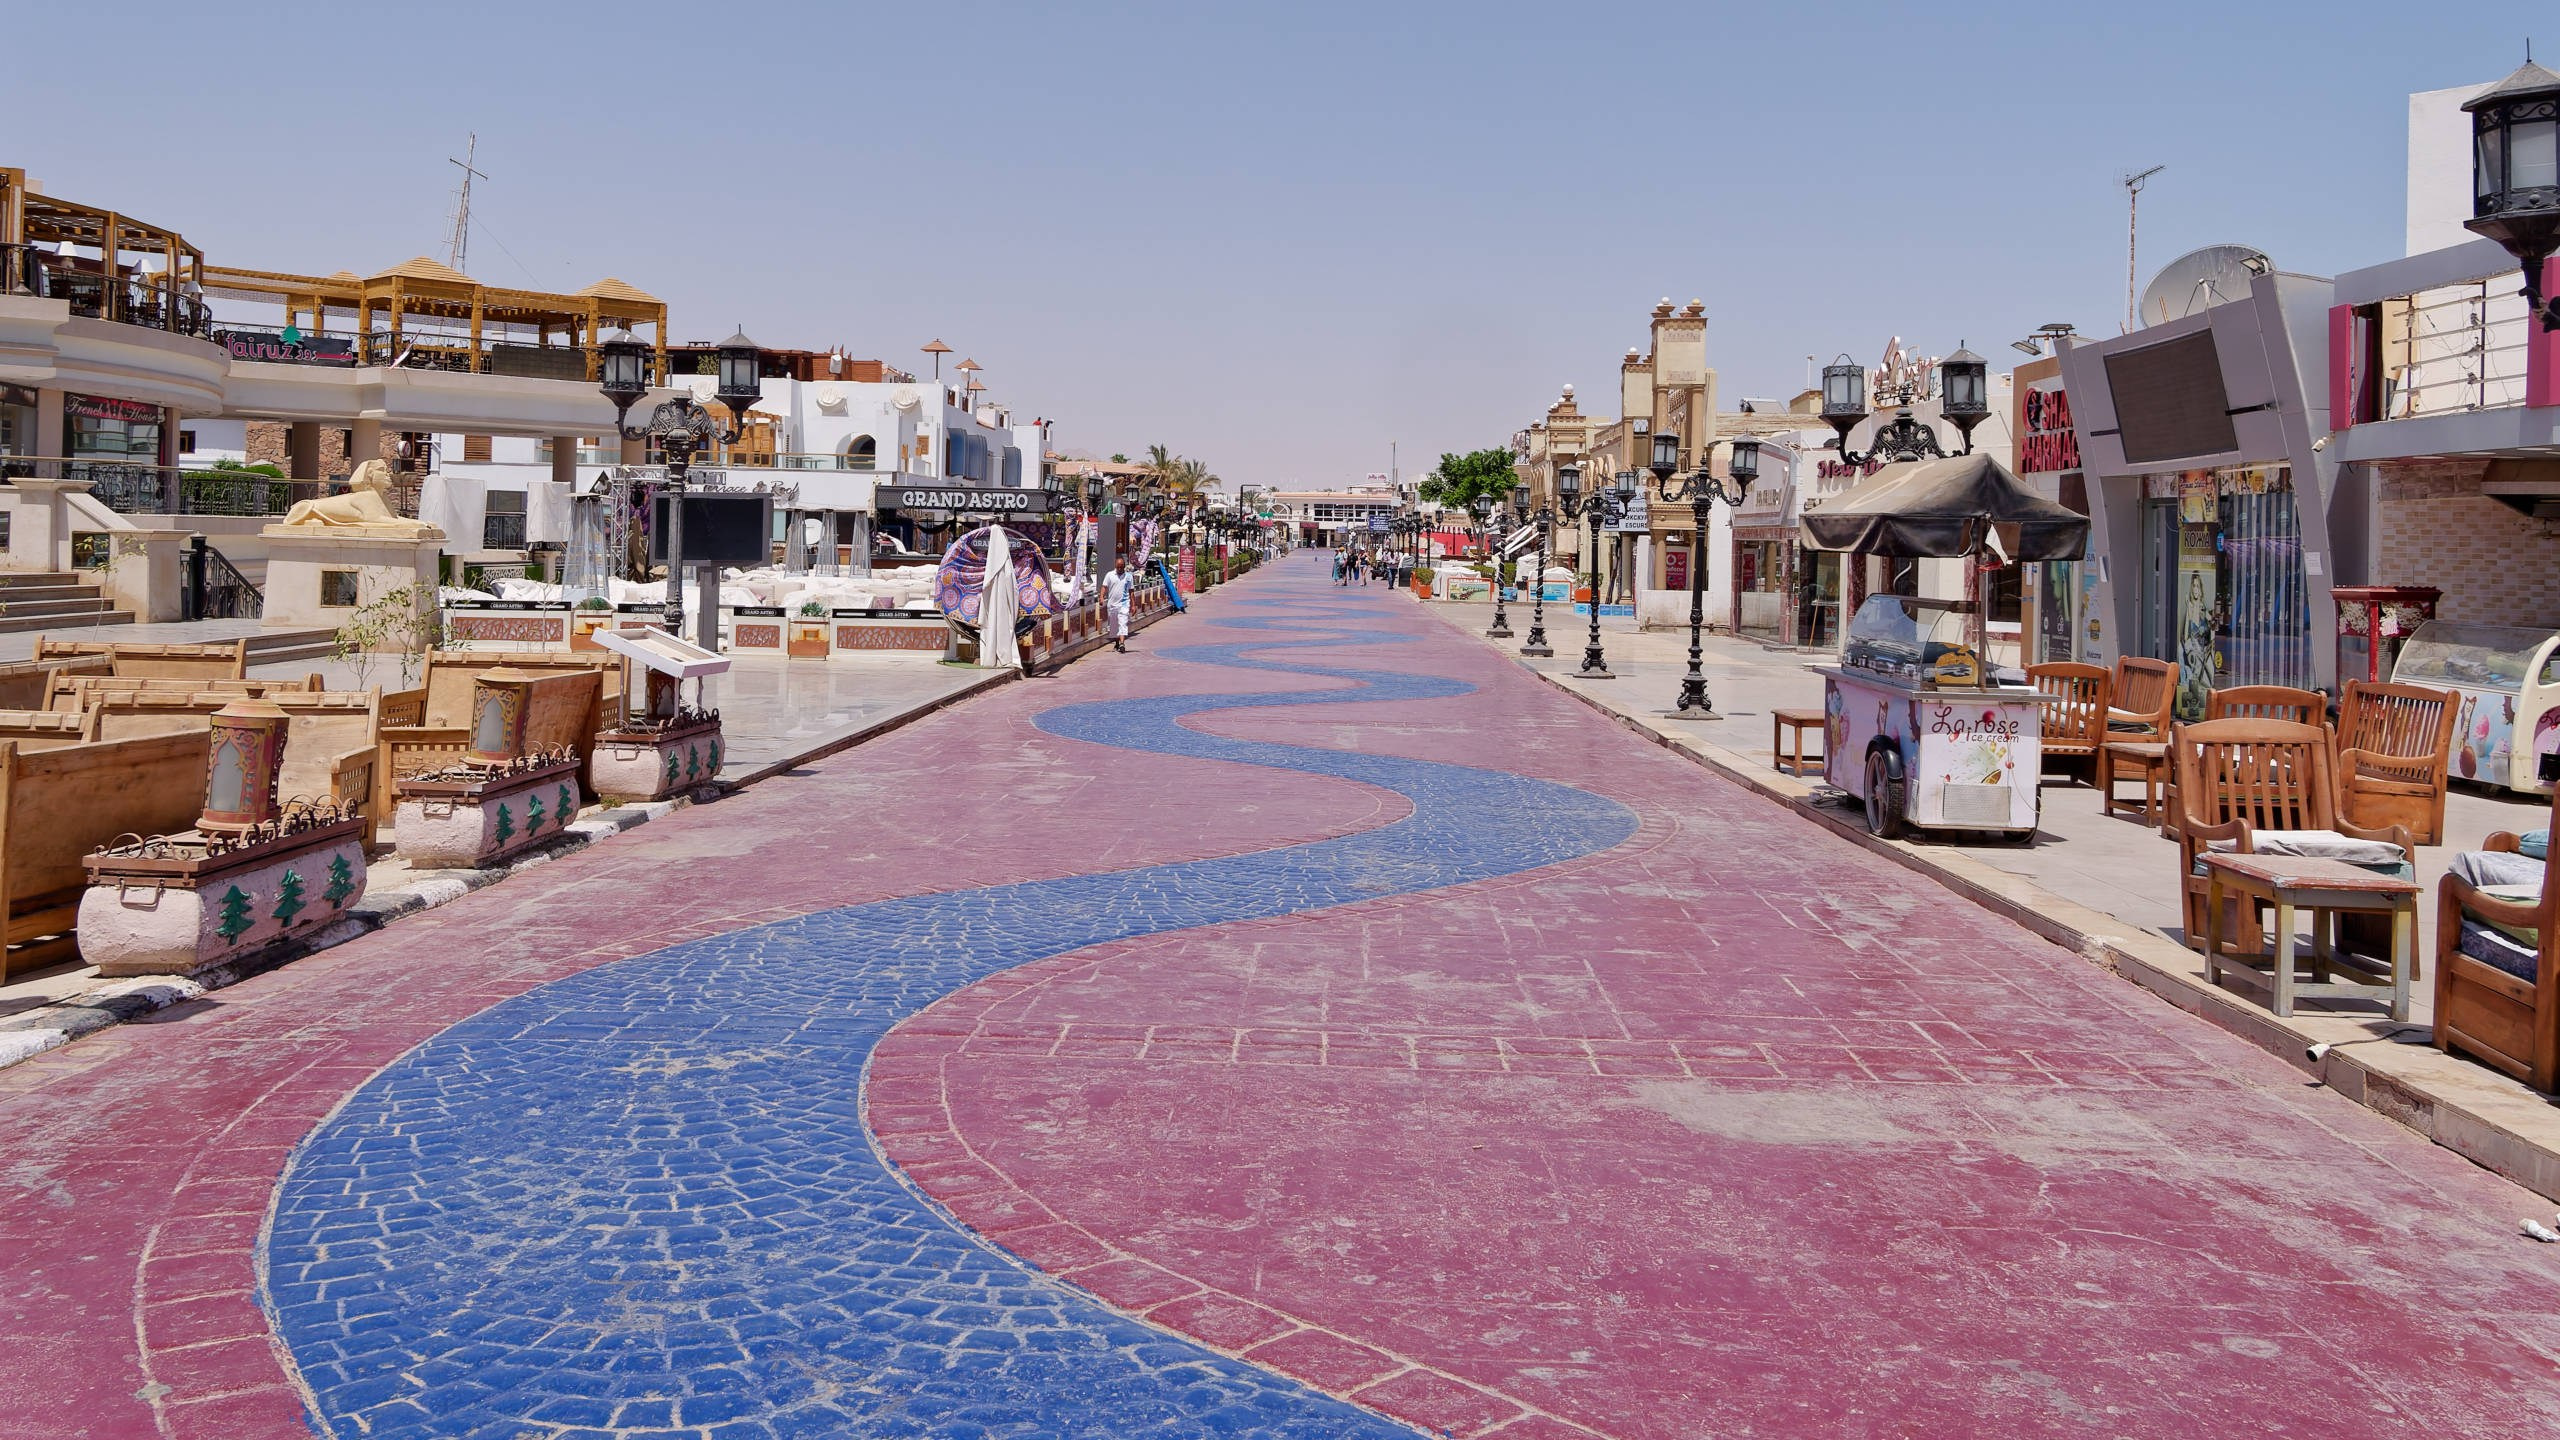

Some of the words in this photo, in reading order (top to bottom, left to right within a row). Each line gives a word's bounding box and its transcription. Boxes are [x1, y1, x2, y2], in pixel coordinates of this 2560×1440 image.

[226, 332, 293, 360] fairuz
[65, 394, 103, 416] French
[127, 405, 157, 422] House
[2042, 390, 2073, 430] SHA
[2020, 432, 2080, 473] PHARMAC
[1817, 460, 1856, 478] New
[902, 491, 966, 508] GRAND
[969, 493, 1028, 509] ASTRO
[1008, 540, 1022, 548] TRO
[1932, 706, 1965, 736] La
[1974, 719, 2019, 734] rose
[1986, 734, 2020, 743] cream
